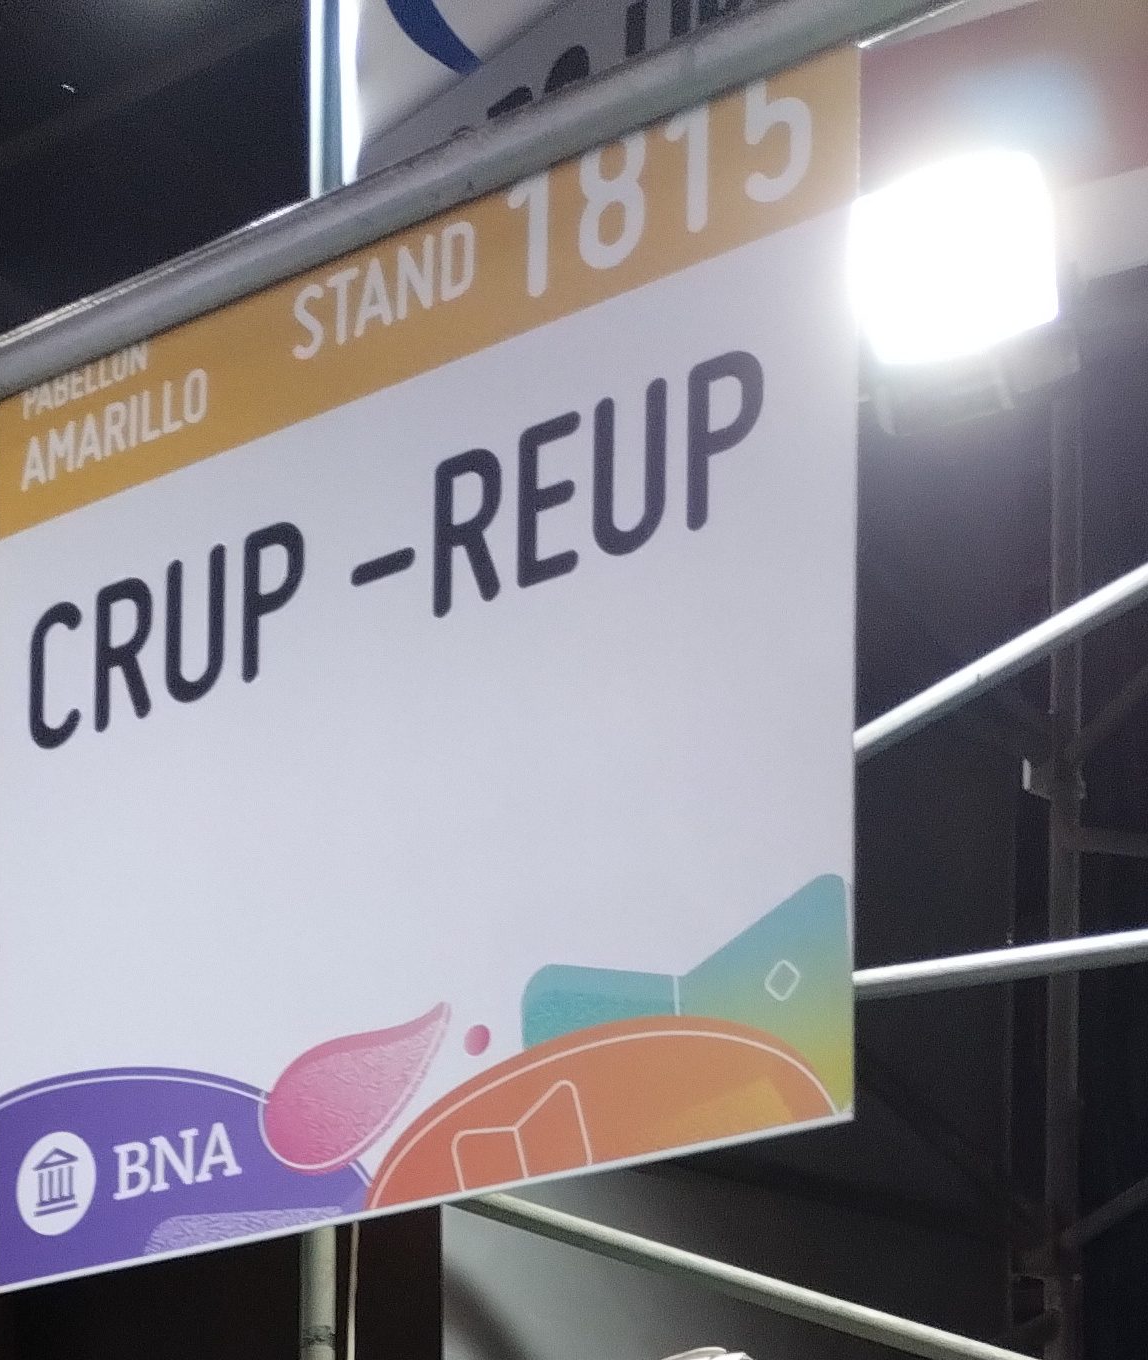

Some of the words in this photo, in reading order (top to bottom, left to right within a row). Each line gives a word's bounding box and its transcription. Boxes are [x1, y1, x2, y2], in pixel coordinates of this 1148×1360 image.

[292, 221, 475, 361] STAND
[505, 80, 814, 298] 1815
[20, 367, 208, 492] AMARILLO
[28, 521, 305, 750] CRUP
[114, 1122, 242, 1201] BNA
